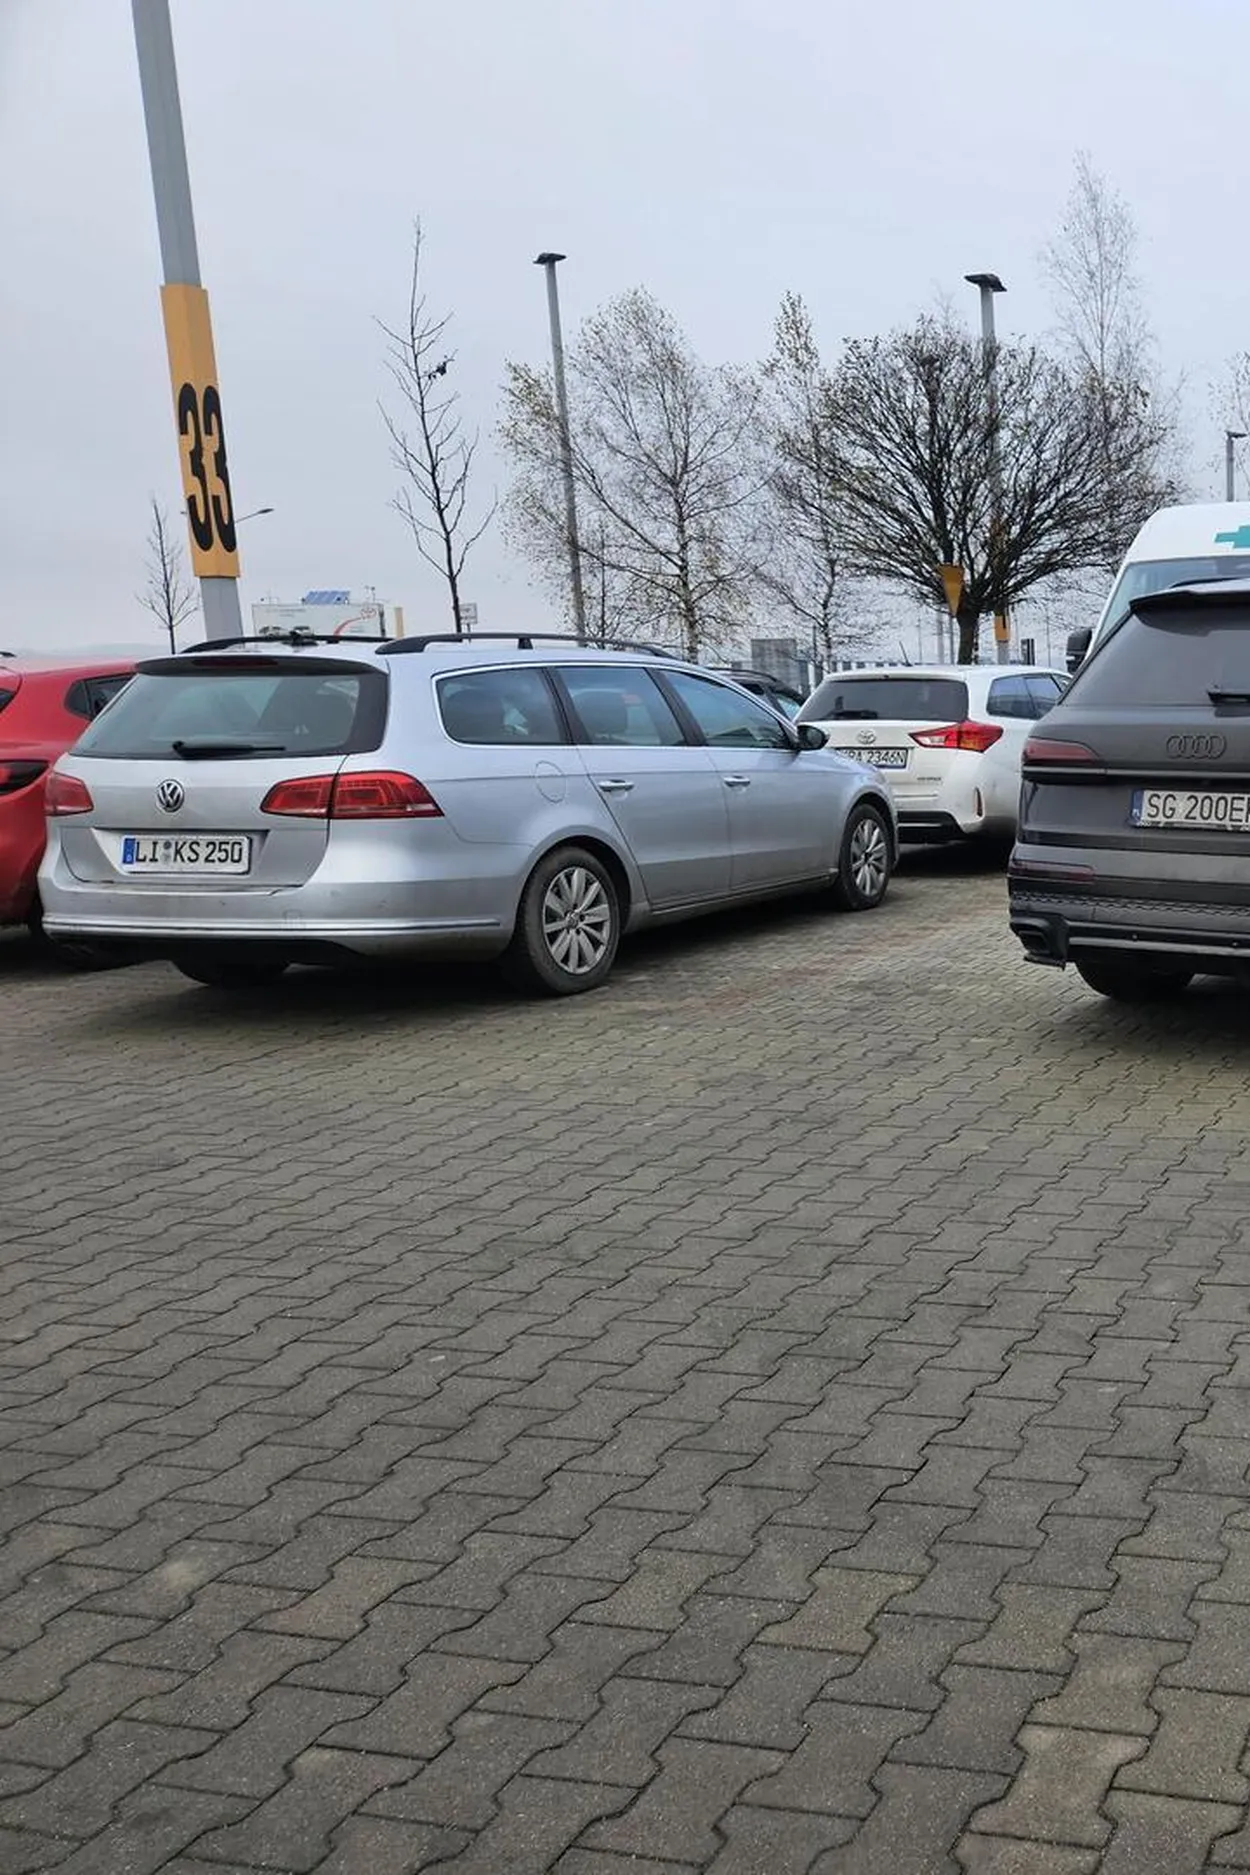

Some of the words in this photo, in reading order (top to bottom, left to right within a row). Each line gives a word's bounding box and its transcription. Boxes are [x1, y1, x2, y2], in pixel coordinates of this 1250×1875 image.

[178, 382, 236, 552] 33
[867, 750, 905, 765] 2346N
[1147, 793, 1177, 819] SG
[204, 841, 243, 864] 250
